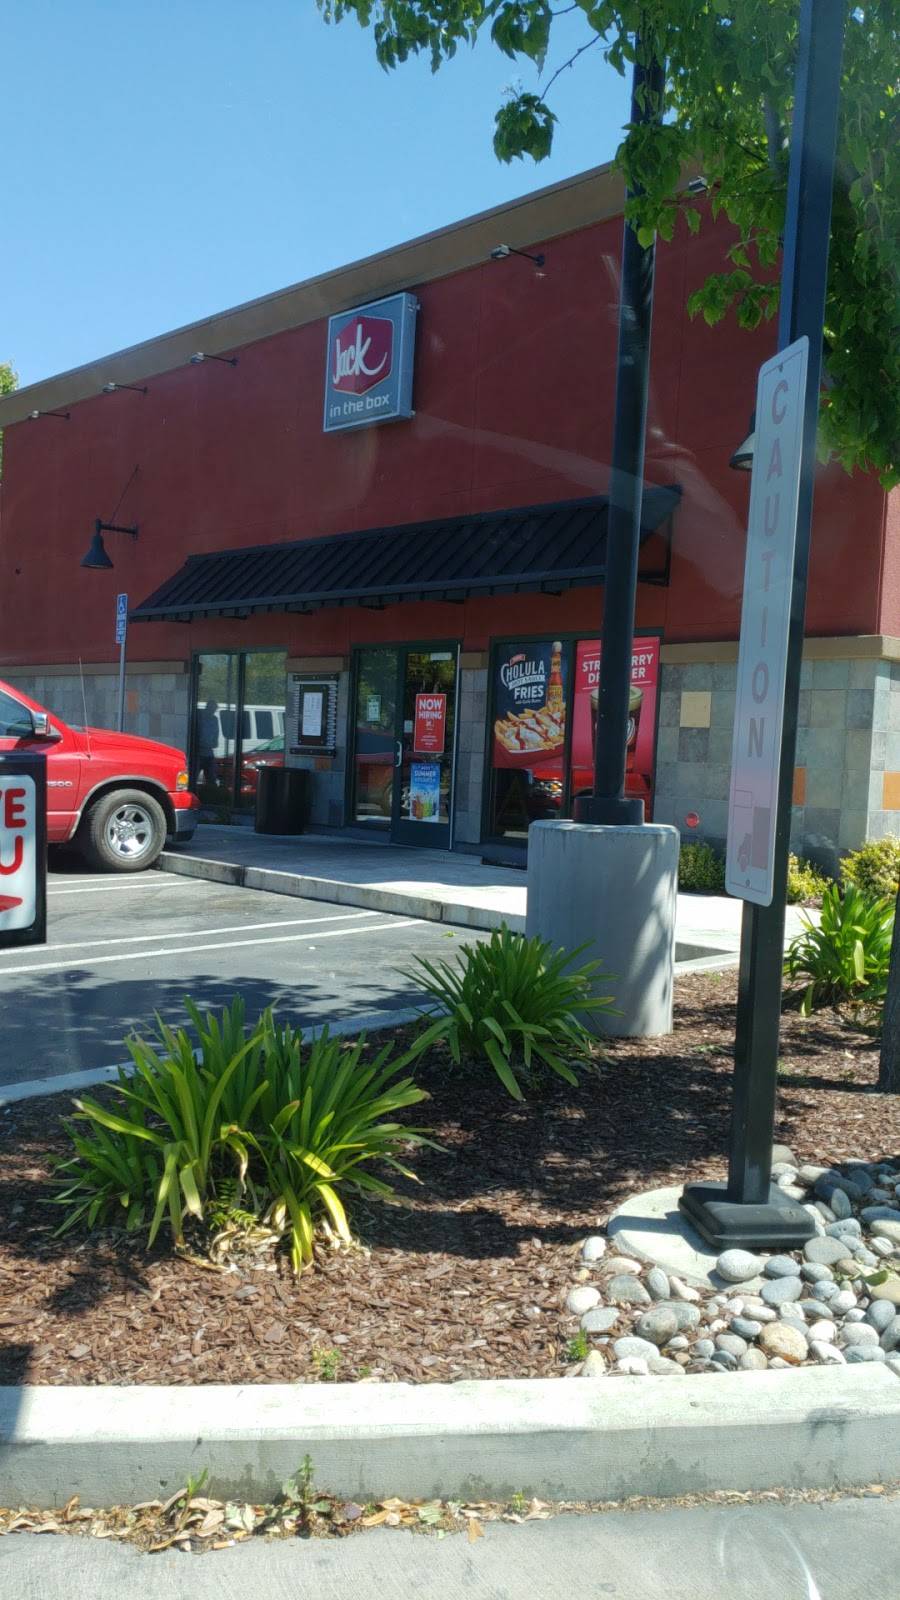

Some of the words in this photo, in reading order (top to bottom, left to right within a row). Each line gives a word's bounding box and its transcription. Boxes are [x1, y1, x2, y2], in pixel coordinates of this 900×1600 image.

[333, 324, 387, 384] Jack
[329, 404, 341, 417] in
[343, 399, 364, 415] the
[366, 394, 390, 410] box
[747, 379, 789, 758] CAUTION
[582, 653, 654, 673] STRRRY
[500, 660, 545, 688] CHOLULA
[514, 685, 544, 700] FRIES
[418, 698, 443, 710] NOW
[418, 710, 442, 720] HIRING
